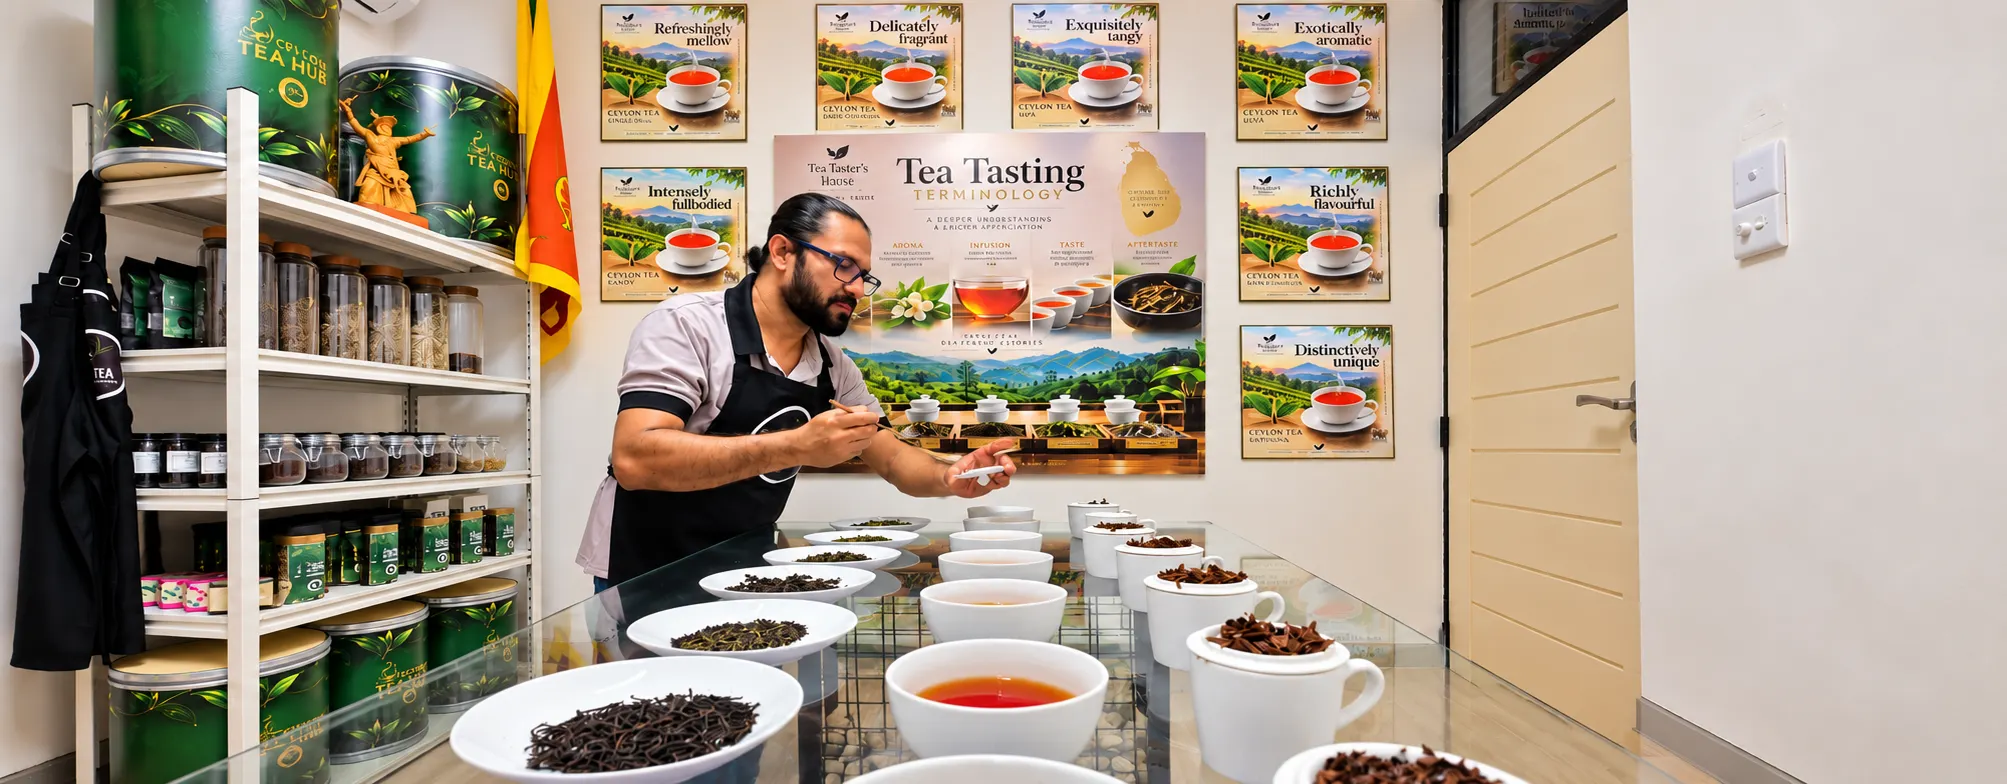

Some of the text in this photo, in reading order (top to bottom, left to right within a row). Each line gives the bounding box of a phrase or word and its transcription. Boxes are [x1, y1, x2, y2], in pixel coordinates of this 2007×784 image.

[654, 22, 732, 37] Refreshingly
[869, 19, 939, 35] Delicately
[1065, 18, 1143, 34] Exquisitely
[1294, 21, 1363, 36] Exotically
[686, 35, 732, 46] mellow
[899, 33, 949, 47] fragrant
[1108, 32, 1143, 45] tangy
[1316, 35, 1372, 46] aromatic
[237, 39, 327, 86] TEA HUB
[644, 109, 660, 117] TEA
[861, 105, 876, 113] TEA
[467, 153, 496, 172] TEA
[807, 163, 869, 173] Tea Taster's
[896, 157, 1085, 192] Tea Tasting
[648, 185, 711, 199] Intensely
[913, 189, 1063, 200] TERMINOLOGY
[1310, 184, 1359, 200] Richly
[672, 198, 732, 210] fullbodied
[1314, 198, 1375, 210] flavourful
[1246, 272, 1282, 280] CEYLON
[1294, 343, 1380, 359] Distinctively
[1333, 356, 1380, 370] unique
[94, 367, 114, 379] TEA
